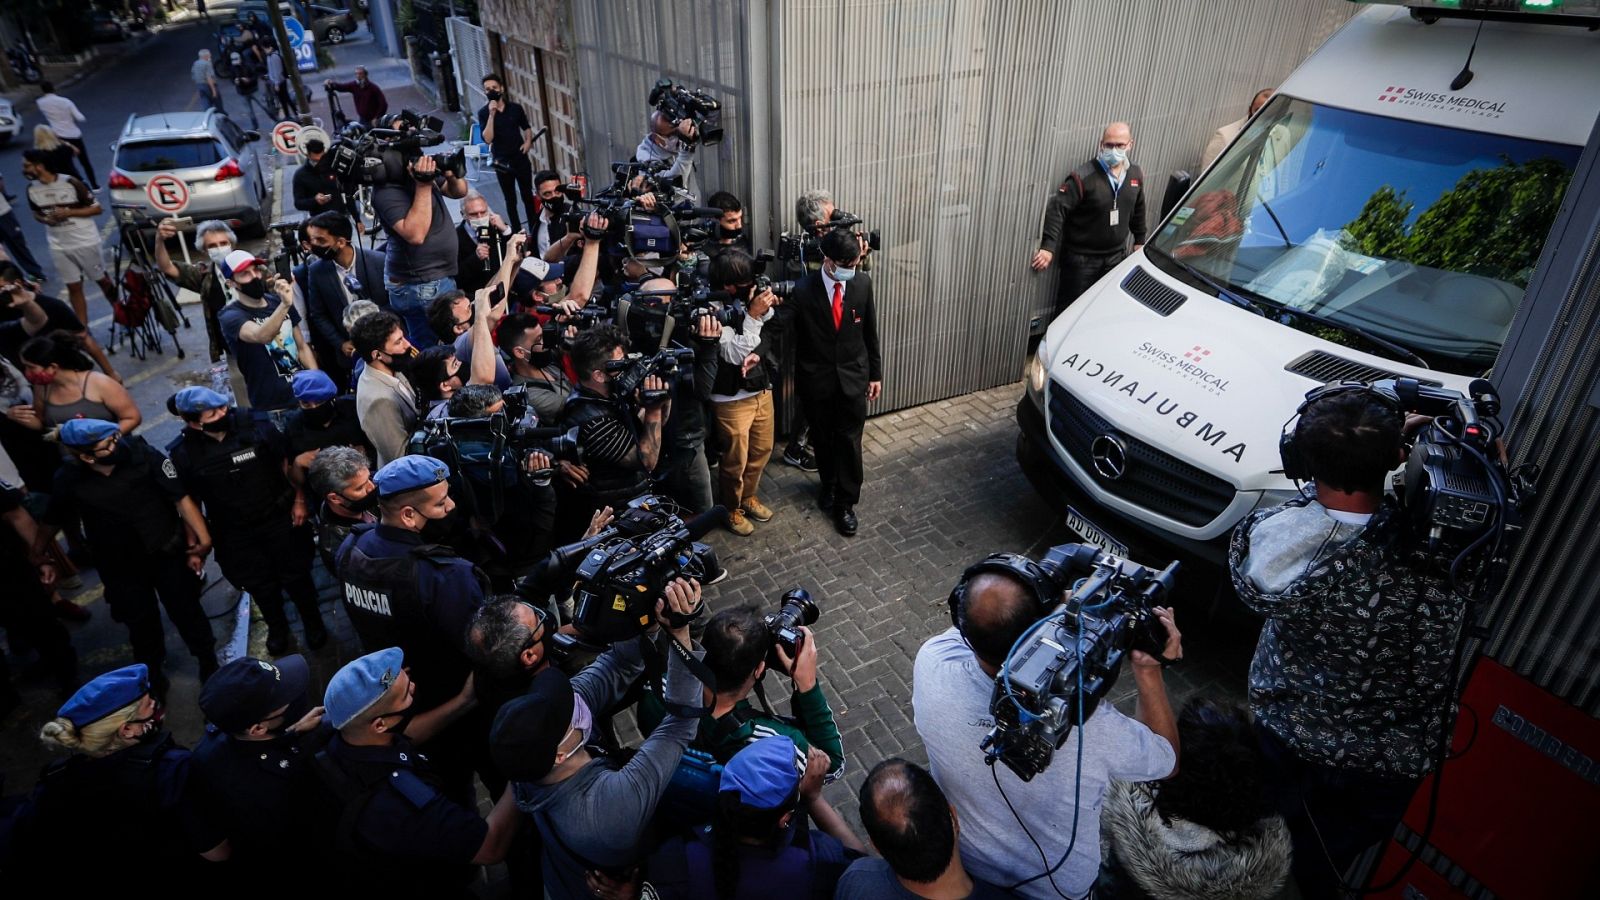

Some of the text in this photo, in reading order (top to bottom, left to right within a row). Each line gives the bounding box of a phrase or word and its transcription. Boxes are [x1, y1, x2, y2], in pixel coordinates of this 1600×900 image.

[1403, 89, 1506, 113] SWISS MEDICAL
[1138, 341, 1231, 393] SWISS MEDICAL
[232, 451, 257, 465] POLICIA
[1069, 516, 1084, 532] AD
[1085, 526, 1107, 550] 004
[344, 582, 394, 617] POLICIA
